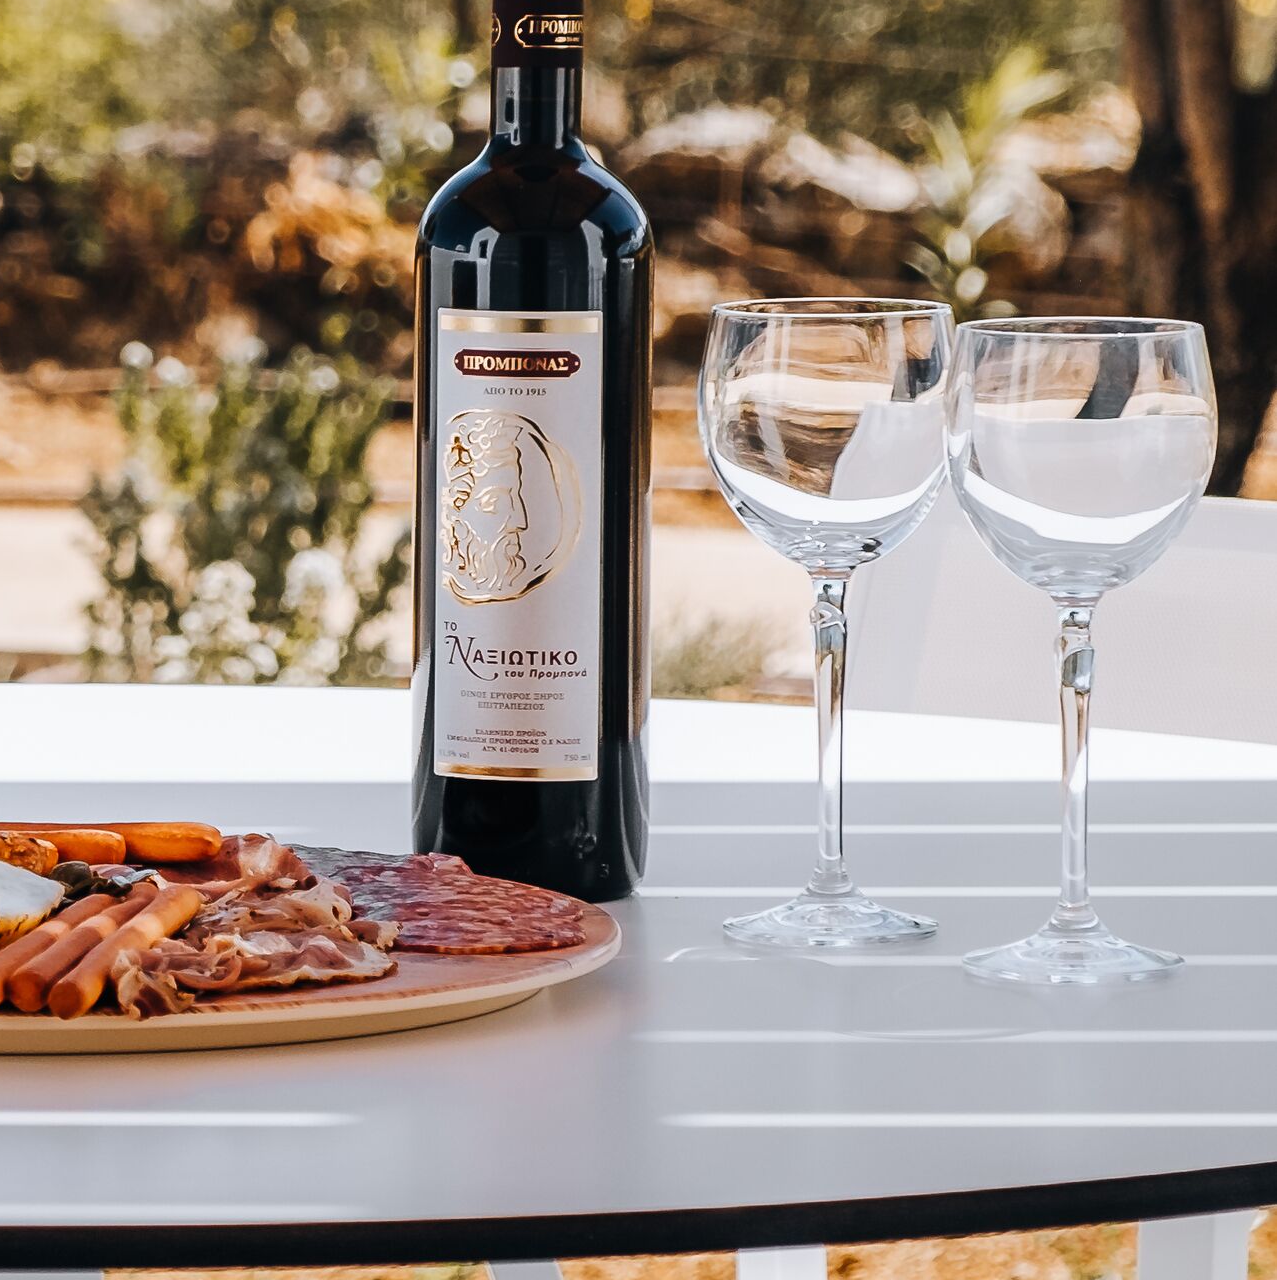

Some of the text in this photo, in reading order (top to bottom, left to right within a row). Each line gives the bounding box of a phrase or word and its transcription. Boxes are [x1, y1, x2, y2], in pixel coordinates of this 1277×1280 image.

[463, 355, 569, 371] ΠΡΟΜΠΟΝΑΣ
[484, 387, 547, 396] ΑΠΟ ΤΟ 1915
[443, 621, 458, 631] ΤΟ
[504, 670, 524, 678] του
